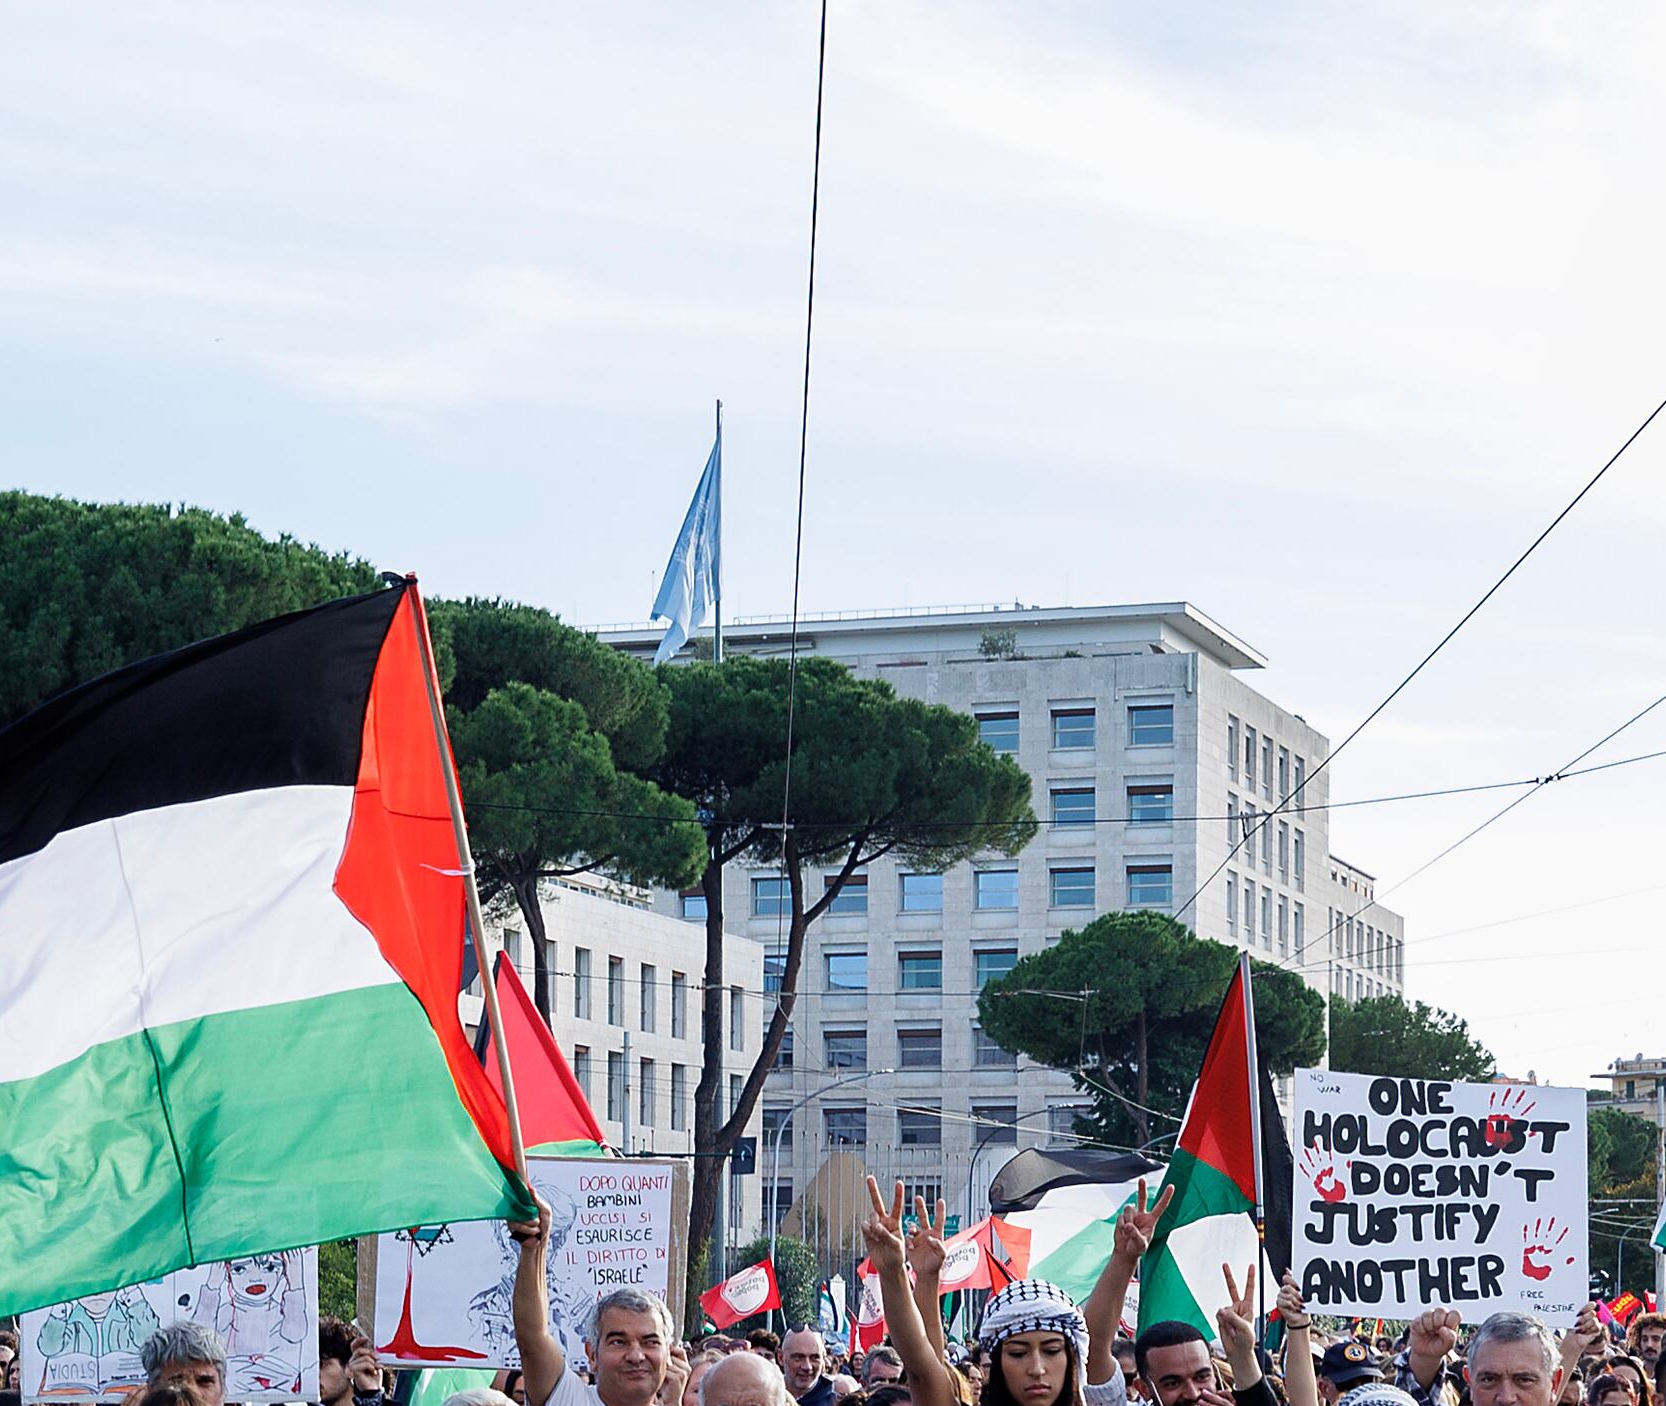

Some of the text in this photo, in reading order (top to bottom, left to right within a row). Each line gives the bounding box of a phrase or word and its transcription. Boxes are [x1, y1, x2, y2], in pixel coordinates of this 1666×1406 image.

[1309, 1073, 1325, 1083] NO
[1317, 1084, 1342, 1094] WAR
[1368, 1077, 1455, 1116] ONE
[1303, 1109, 1571, 1159] HOLOCAUST
[579, 1175, 669, 1192] DOPO QUANTI
[1351, 1160, 1555, 1202] DOESN'T
[587, 1193, 642, 1209] BAMBINI
[580, 1211, 651, 1226] UCCISI SI
[1304, 1200, 1501, 1246] JUSTIFY
[576, 1227, 653, 1245] ESAURISCE
[565, 1247, 666, 1265] IL DIRITTO DI
[1301, 1254, 1505, 1305] ANOTHER
[1520, 1290, 1545, 1300] FREE
[1533, 1303, 1576, 1313] PALESTINE
